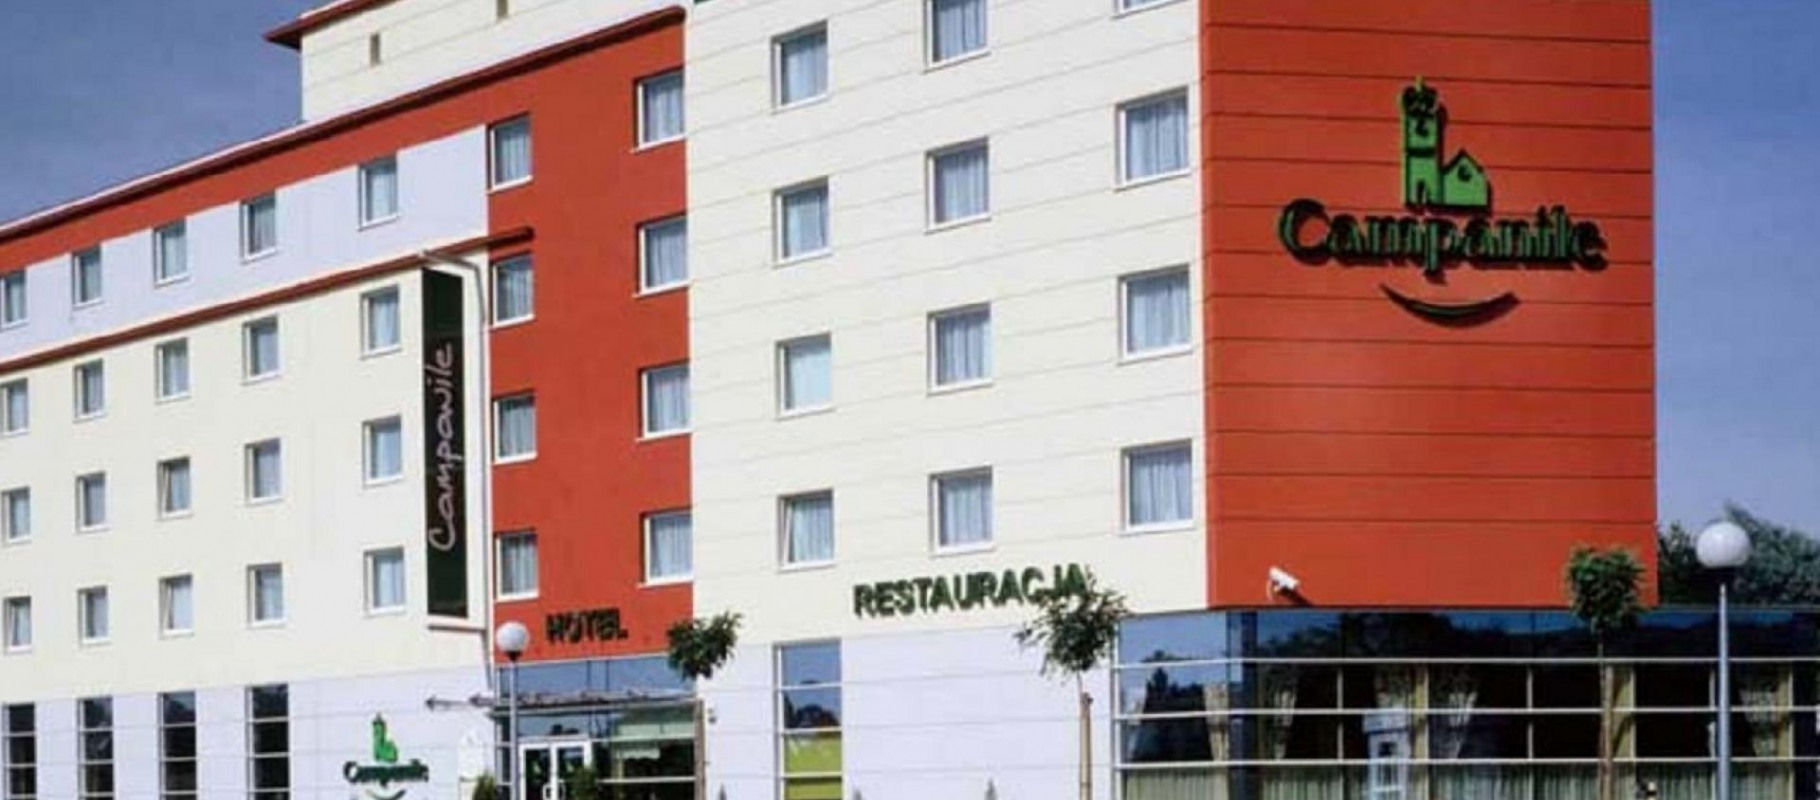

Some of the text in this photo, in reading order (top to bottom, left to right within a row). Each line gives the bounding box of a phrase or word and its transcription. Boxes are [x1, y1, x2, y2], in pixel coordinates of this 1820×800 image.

[1278, 198, 1609, 285] Campanile
[425, 343, 462, 551] Campanile
[853, 562, 1087, 618] RESTAURACJA
[546, 608, 629, 646] HOTEL
